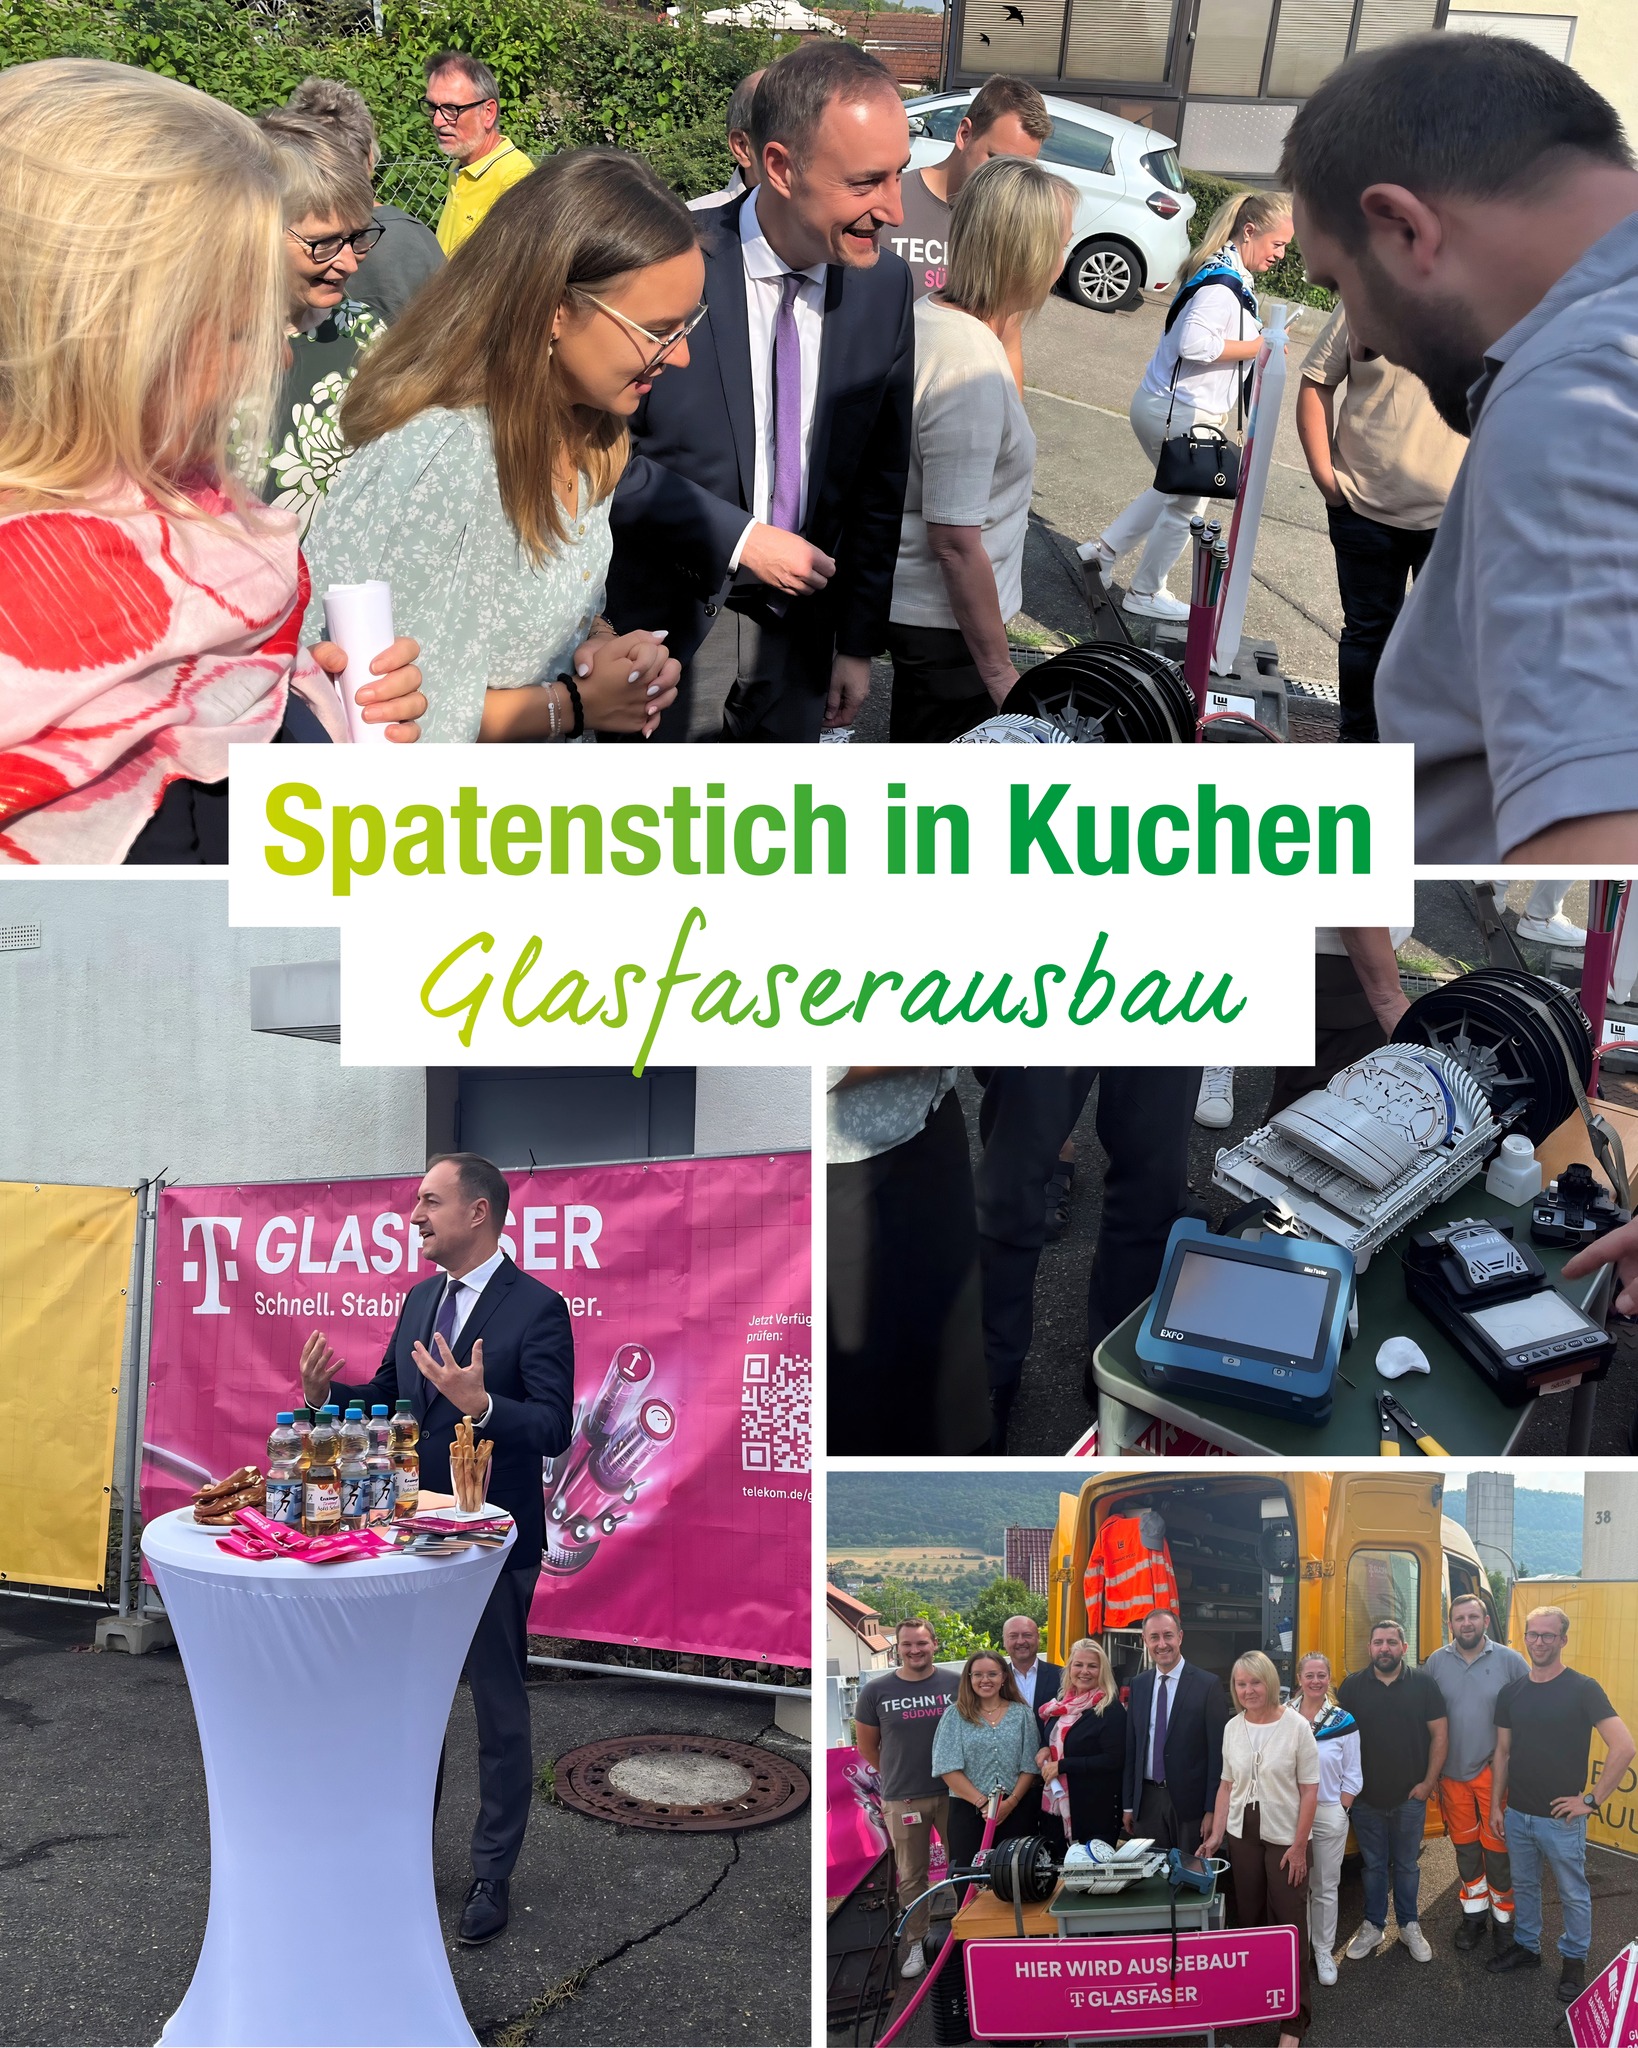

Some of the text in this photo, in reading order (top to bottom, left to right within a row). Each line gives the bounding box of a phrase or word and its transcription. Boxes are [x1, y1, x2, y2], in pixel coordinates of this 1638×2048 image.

[891, 238, 948, 265] TEC
[254, 1204, 604, 1275] GLASFSER
[254, 1291, 335, 1316] Schnell.
[748, 1314, 774, 1326] Jetzt
[746, 1329, 783, 1345] prüfen:
[1160, 1328, 1184, 1341] EXFO
[1594, 1509, 1612, 1525] 38
[881, 1693, 954, 1713] TECHN1K
[1015, 1951, 1250, 1978] HIER WIRD AUSGEBAUT
[1088, 1986, 1198, 2008] GLASFASER
